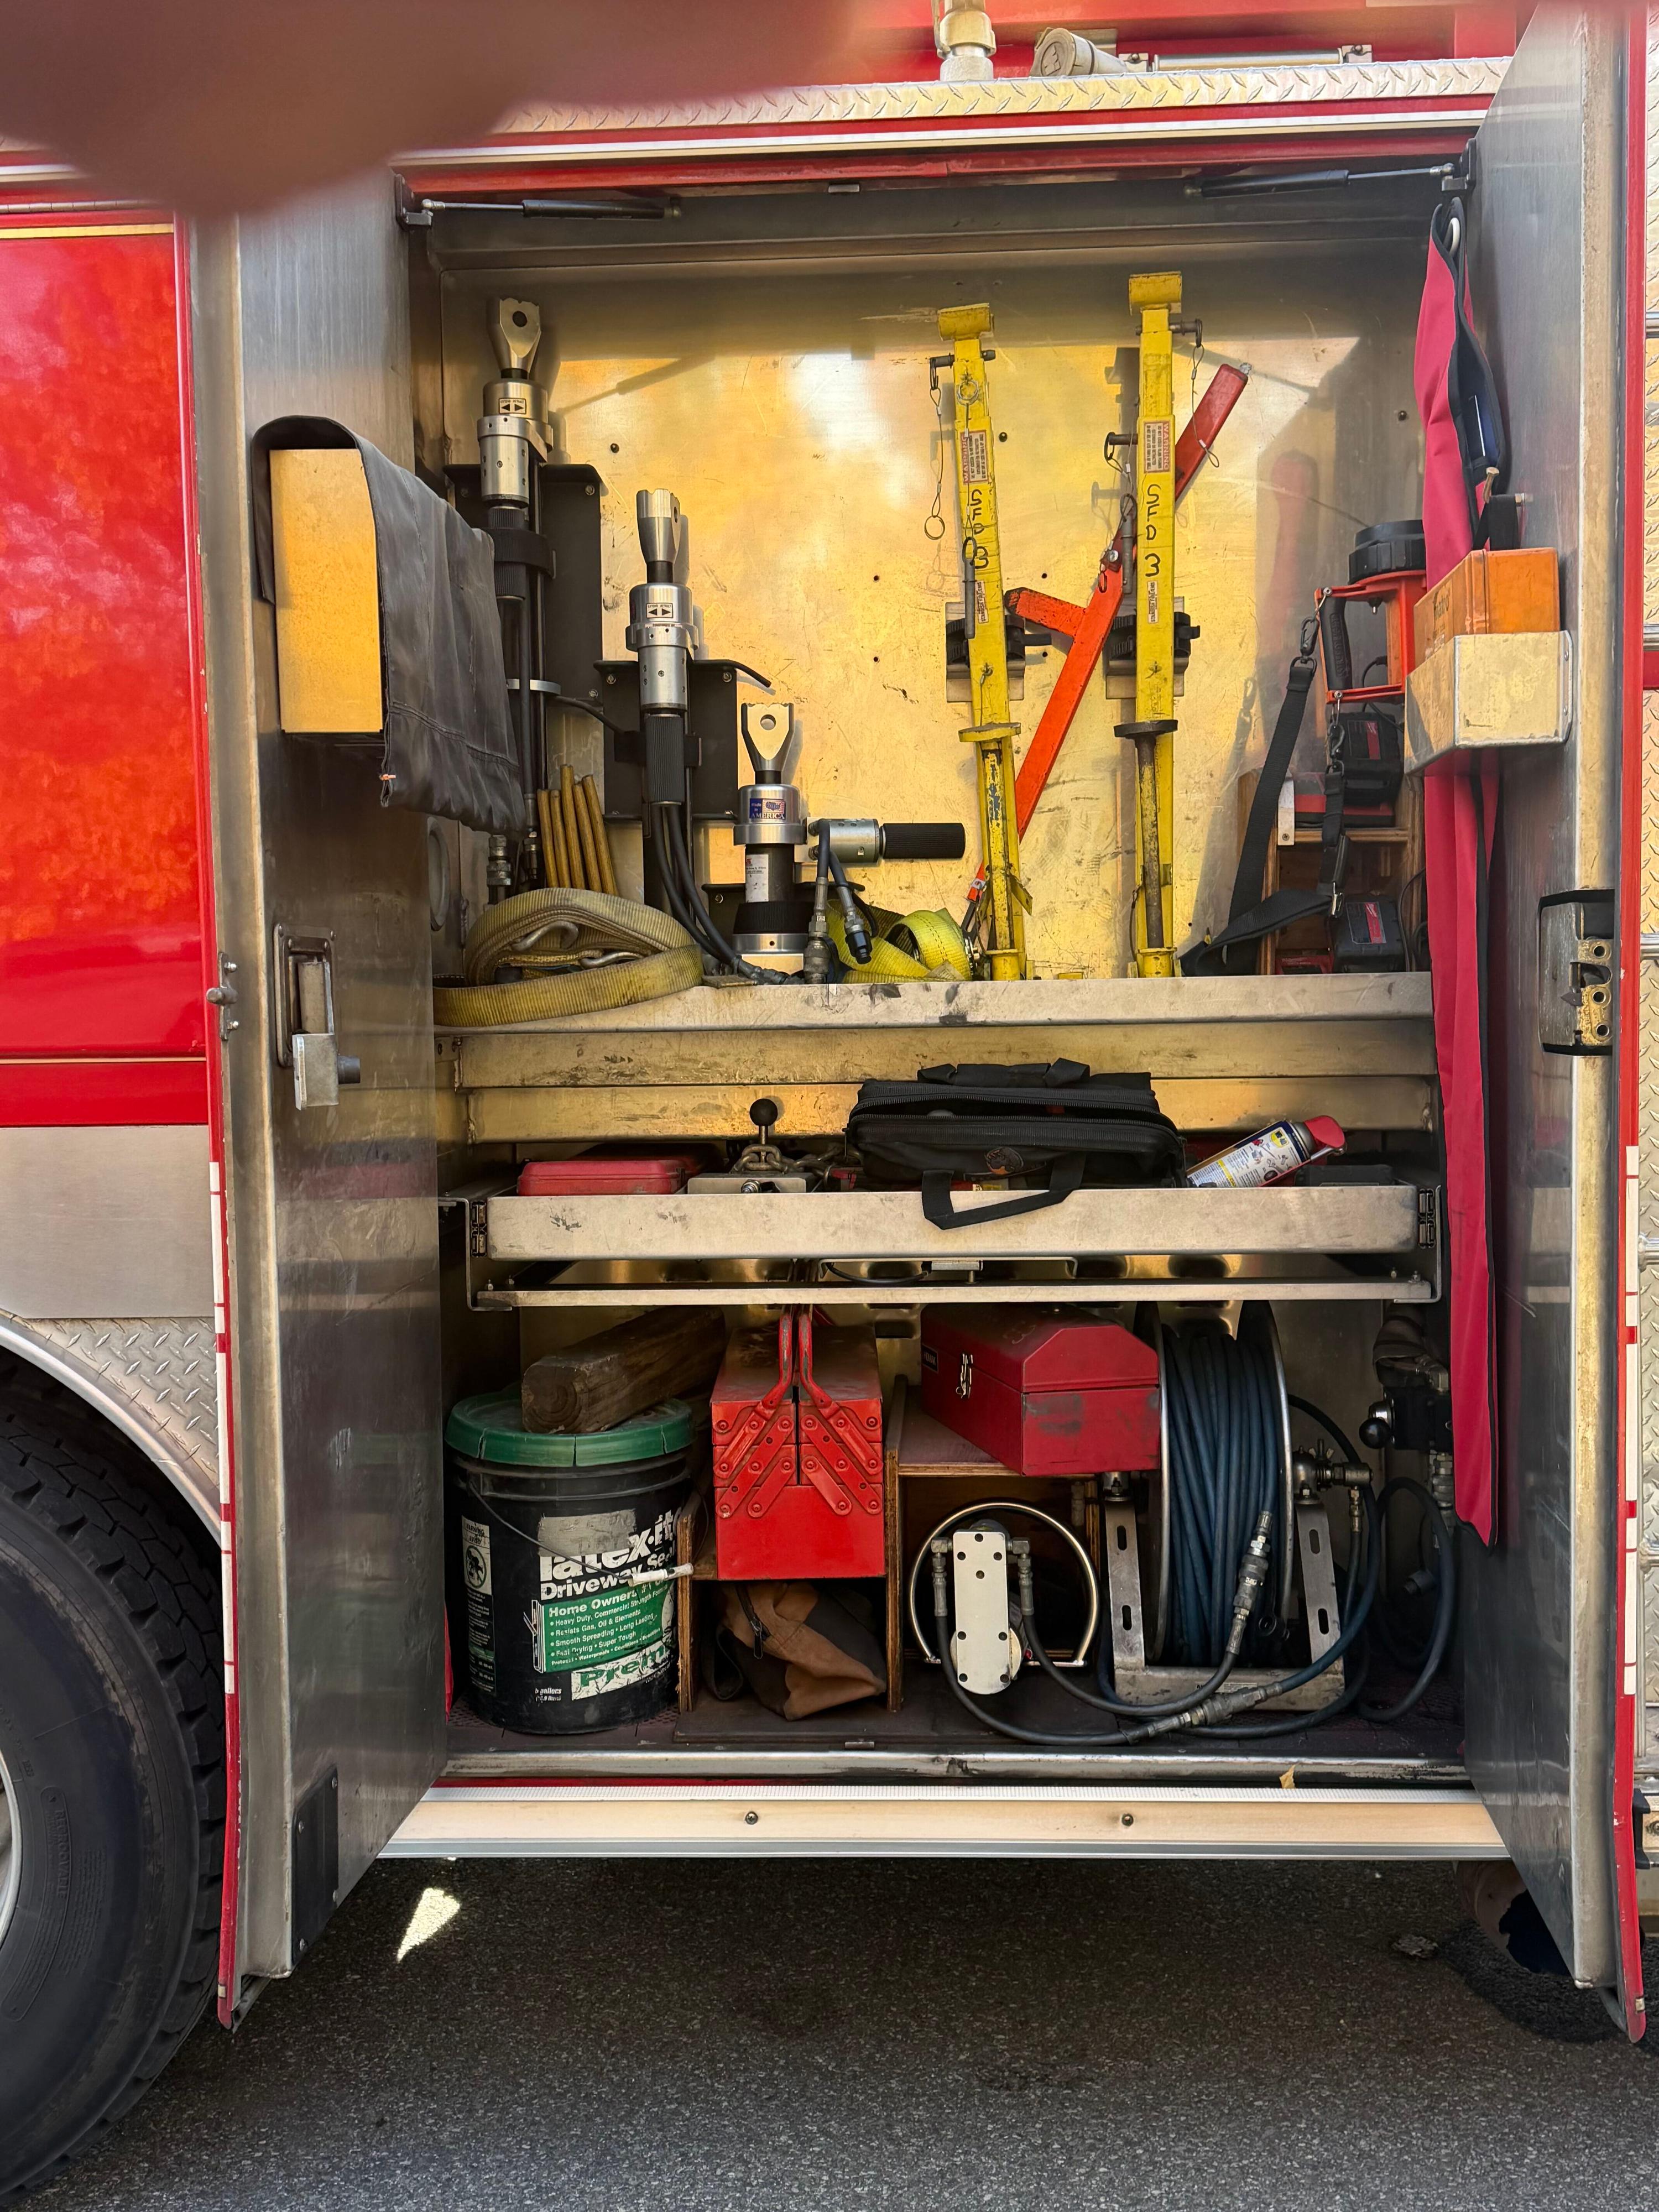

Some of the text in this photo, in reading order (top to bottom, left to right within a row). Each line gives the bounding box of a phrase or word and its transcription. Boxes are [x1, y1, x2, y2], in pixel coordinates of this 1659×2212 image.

[541, 1563, 642, 1601] Driveway
[549, 1605, 587, 1618] Home
[555, 1618, 575, 1627] Heavy
[576, 1614, 593, 1623] Duty,
[594, 1603, 629, 1619] Commercial
[556, 1627, 580, 1637] Resists
[582, 1624, 596, 1632] Gas,
[598, 1619, 607, 1628] Oil
[614, 1609, 641, 1624] Elements
[556, 1613, 654, 1647] Smooth Spreading Long Lasting
[598, 1638, 617, 1648] Super
[618, 1631, 636, 1642] Tough
[578, 1650, 609, 1661] Waterproofs
